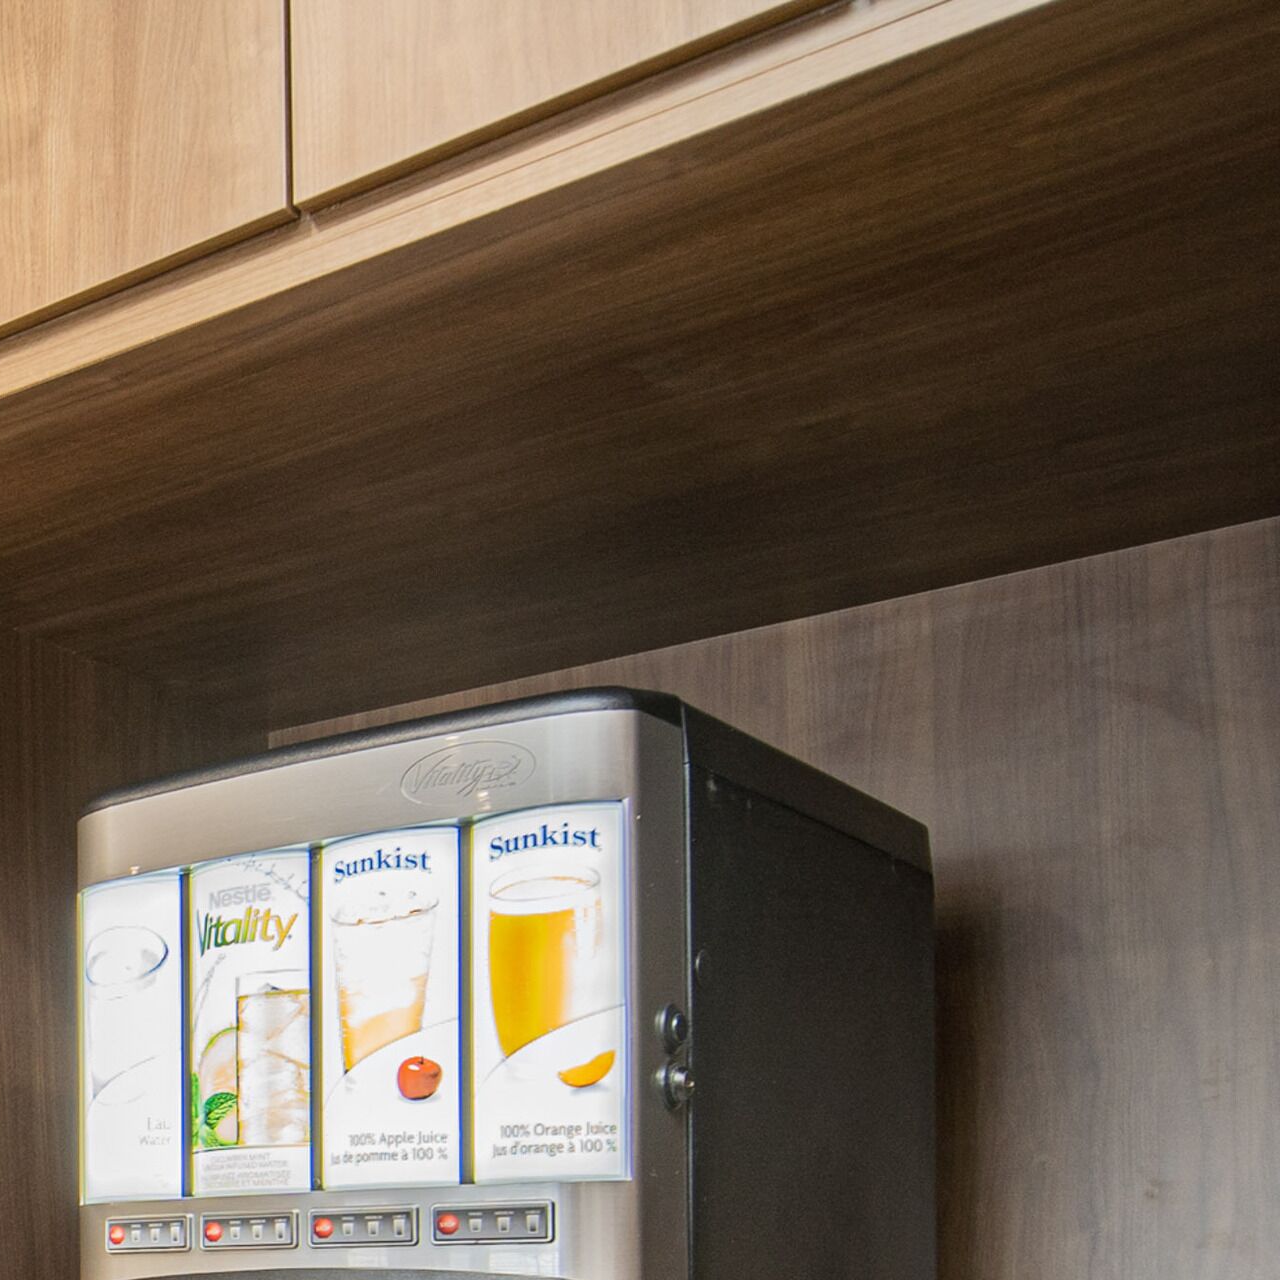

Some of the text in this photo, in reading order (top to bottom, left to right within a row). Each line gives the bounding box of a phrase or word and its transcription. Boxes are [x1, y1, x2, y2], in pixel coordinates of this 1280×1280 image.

[489, 822, 601, 862] Sunkist
[334, 846, 432, 885] Sunkist
[196, 904, 299, 958] Vitality
[348, 1130, 448, 1147] 100% Apple Juice
[500, 1120, 617, 1139] 100% Orange Juice
[579, 1138, 604, 1153] 100
[354, 1150, 399, 1167] pomme
[412, 1147, 434, 1161] 100
